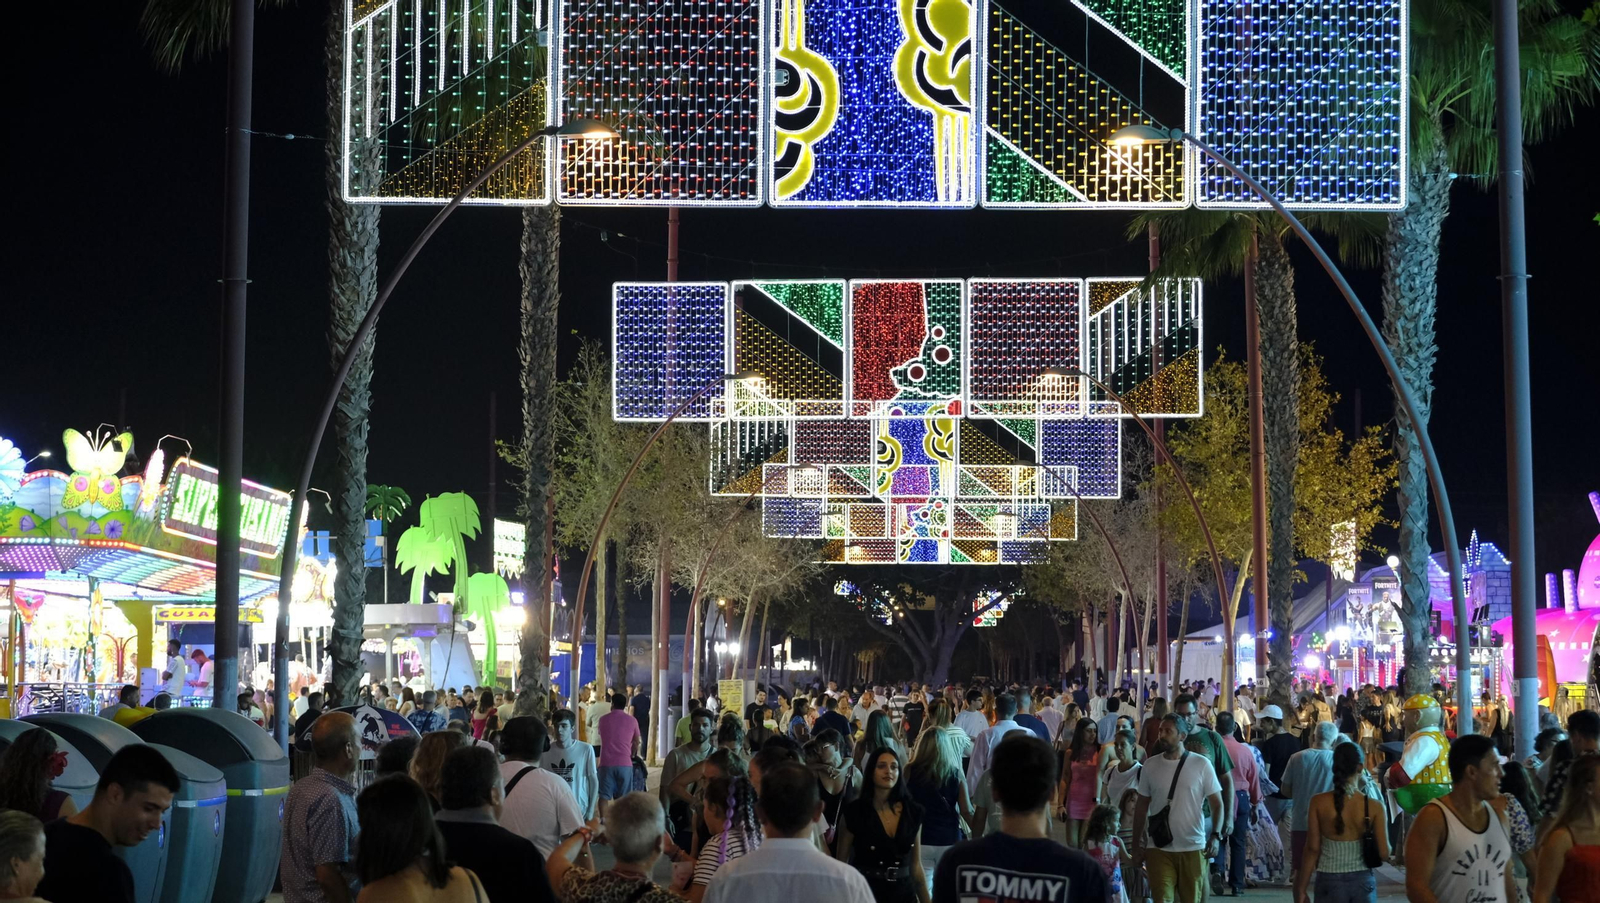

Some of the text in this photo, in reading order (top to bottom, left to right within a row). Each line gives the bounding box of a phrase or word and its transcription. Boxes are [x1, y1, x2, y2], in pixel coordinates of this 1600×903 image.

[171, 473, 288, 547] SUPE USANO
[961, 870, 1063, 902] TOMMY
